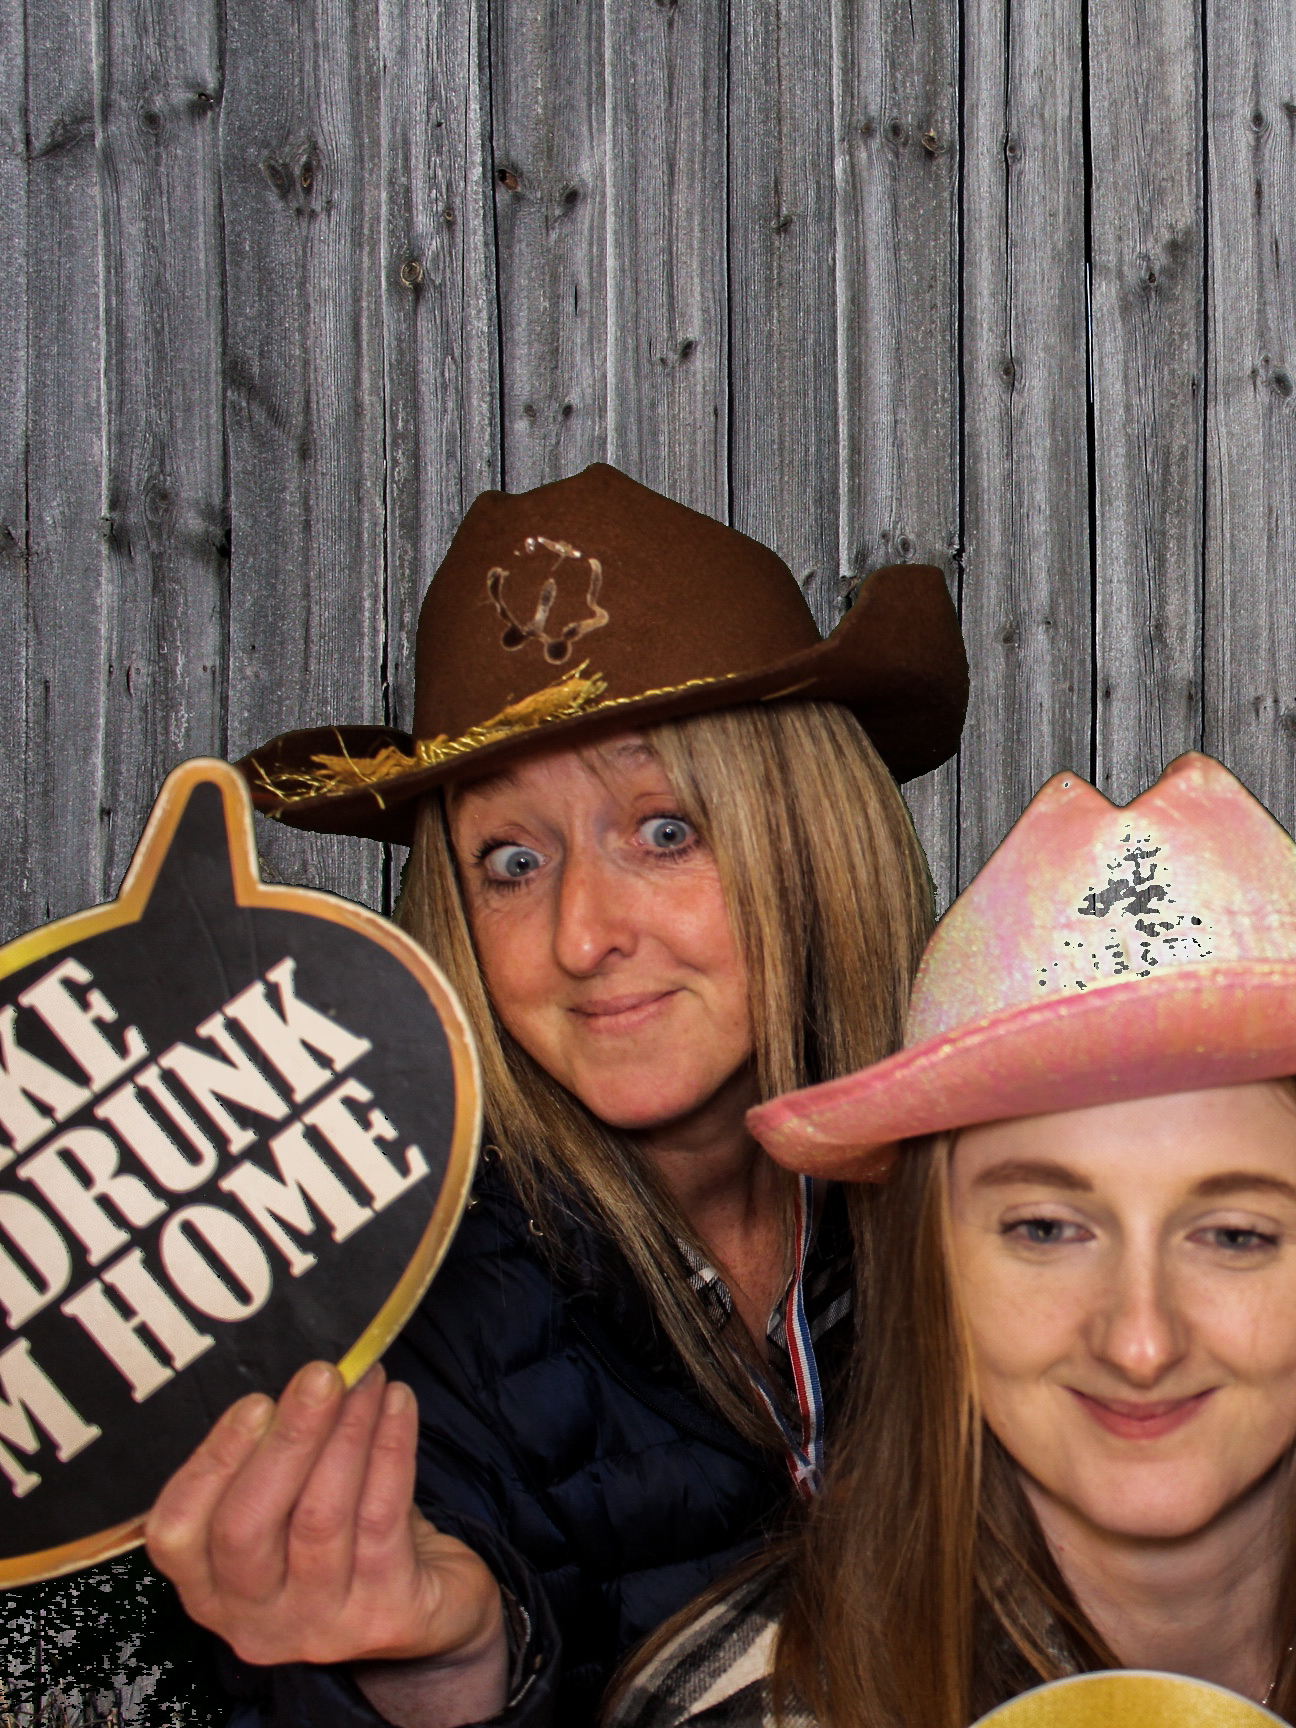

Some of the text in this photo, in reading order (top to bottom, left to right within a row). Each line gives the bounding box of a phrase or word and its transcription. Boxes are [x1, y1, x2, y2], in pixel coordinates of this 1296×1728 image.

[0, 957, 150, 1169] KE
[0, 957, 373, 1330] DRUNK
[60, 1077, 431, 1403] HOME
